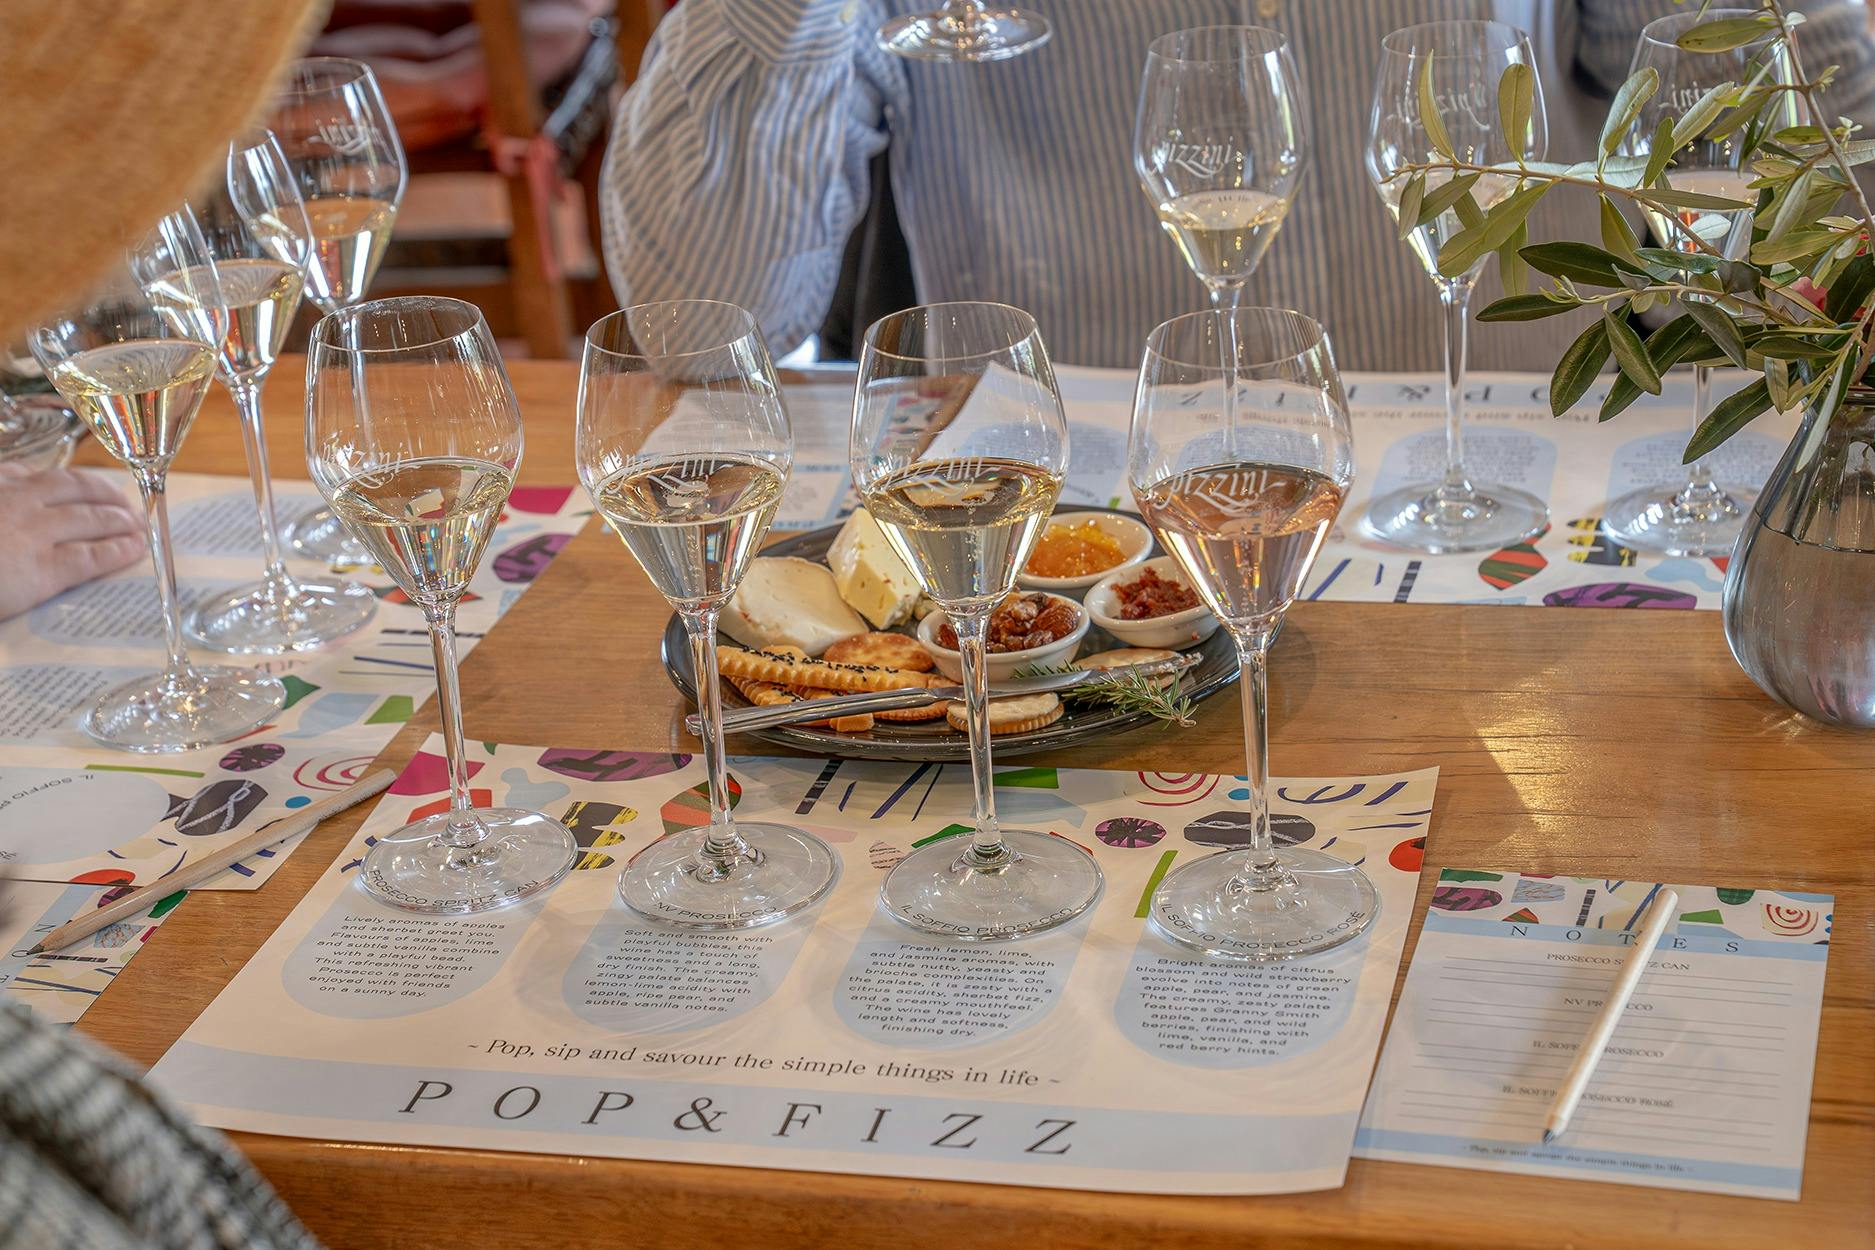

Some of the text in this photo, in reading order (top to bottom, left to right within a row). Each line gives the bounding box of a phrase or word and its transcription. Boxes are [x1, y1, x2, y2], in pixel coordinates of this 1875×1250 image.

[370, 869, 540, 907] PROSECCO SPRITZ CAN
[678, 905, 777, 920] PROSECCO
[343, 916, 384, 925] Lively
[901, 904, 912, 914] IL
[913, 912, 971, 934] SOFFIO
[371, 926, 422, 934] sherbet
[1161, 902, 1173, 914] IL
[1219, 934, 1324, 950] PROSECCO
[625, 929, 652, 937] Soft
[330, 932, 390, 941] Flavours
[412, 937, 460, 945] apples,
[1510, 925, 1740, 953] NOTES
[623, 938, 670, 947] playful
[675, 941, 731, 950] bubbles,
[900, 944, 940, 952] Fresh
[379, 952, 426, 961] playful
[700, 951, 738, 959] touch
[900, 954, 956, 962] jasmine
[348, 960, 419, 970] refreshing
[425, 963, 473, 971] vibrant
[606, 955, 680, 964] sweetness
[728, 961, 760, 970] long,
[1158, 958, 1203, 967] Bright
[1546, 953, 1611, 966] PROSECCO
[1661, 961, 1691, 971] CAN
[318, 967, 384, 976] Prosecco
[404, 972, 455, 980] perfect
[597, 962, 620, 971] dry
[625, 964, 665, 972] finish.
[704, 969, 758, 978] creamy,
[865, 968, 917, 977] brioche
[966, 967, 1014, 976] yeasty
[597, 972, 634, 980] zingy
[687, 976, 749, 985] balances
[1136, 966, 1195, 975] blossom
[1269, 974, 1350, 986] strawberry
[1142, 976, 1188, 984] evolve
[1195, 978, 1222, 986] into
[402, 980, 451, 988] friends
[585, 979, 664, 989] lemon-lime
[669, 985, 716, 994] acidity
[964, 984, 1003, 992] zesty
[354, 988, 396, 996] sunny
[400, 989, 427, 998] day.
[590, 990, 630, 998] apple,
[636, 992, 663, 1000] ripe
[954, 992, 1008, 1000] sherbet
[895, 998, 950, 1007] creamy
[685, 1004, 727, 1012] notes.
[1604, 1046, 1665, 1058] ROSECCO
[486, 1039, 1039, 1087] Pop, sip and savour the simple things in life
